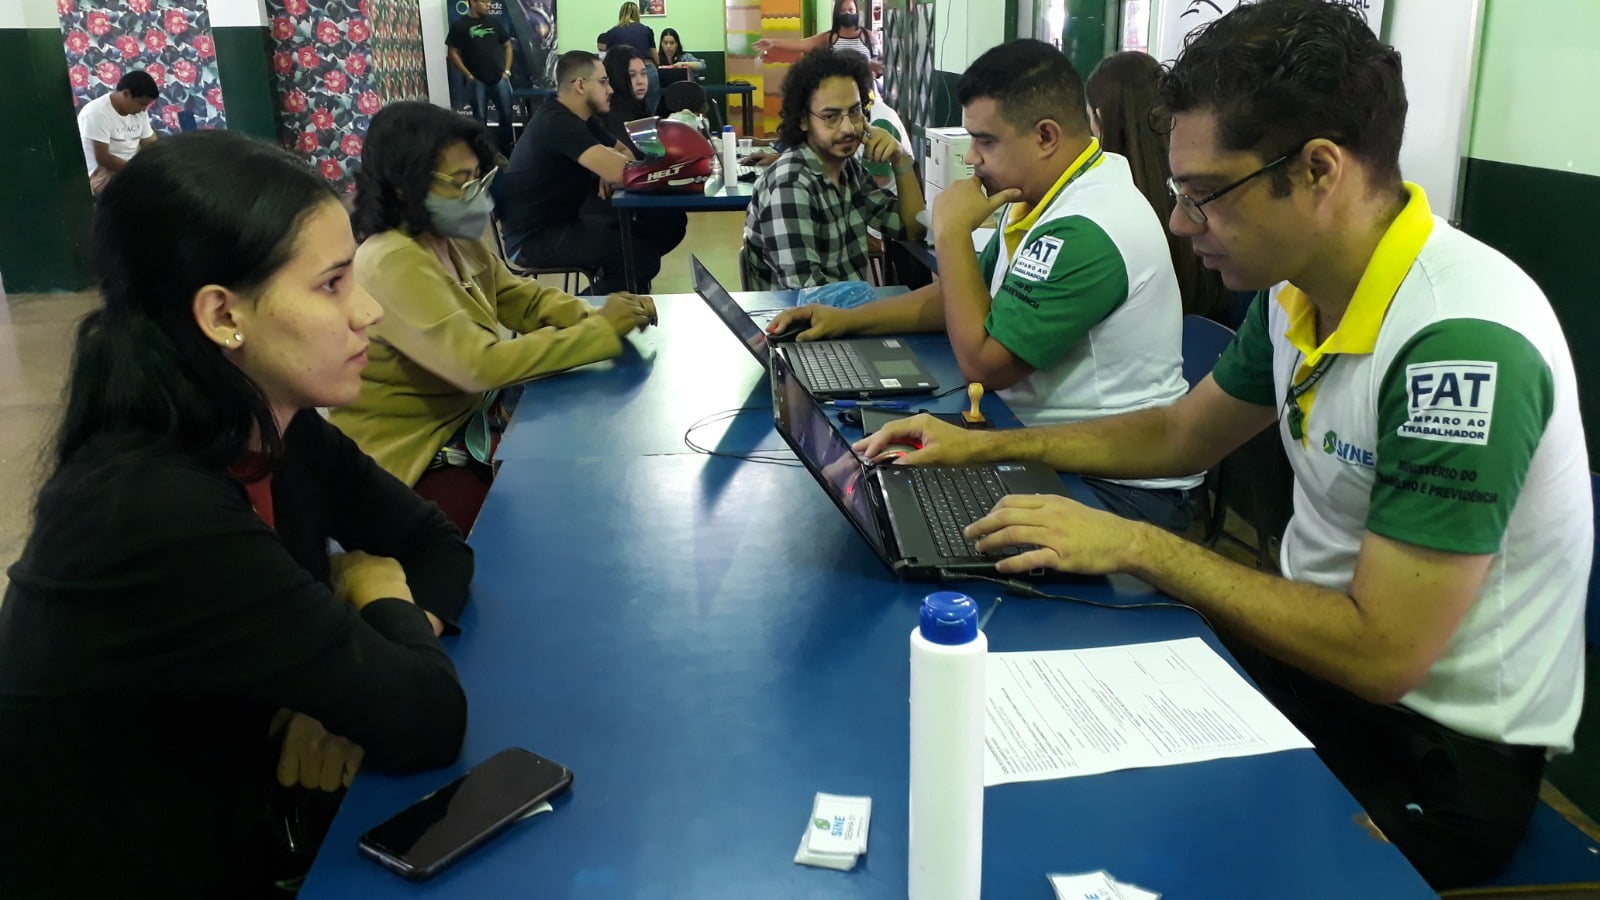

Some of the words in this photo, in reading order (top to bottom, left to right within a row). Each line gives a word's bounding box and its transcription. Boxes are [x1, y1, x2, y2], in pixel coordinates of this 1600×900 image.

[647, 165, 684, 181] HELT
[1411, 372, 1491, 408] FAT
[1412, 415, 1461, 426] MPARO
[1467, 418, 1486, 428] AO
[1402, 425, 1485, 439] TRABALHADOR
[1336, 440, 1374, 465] SINE
[1460, 469, 1477, 482] DO
[1420, 483, 1428, 494] E
